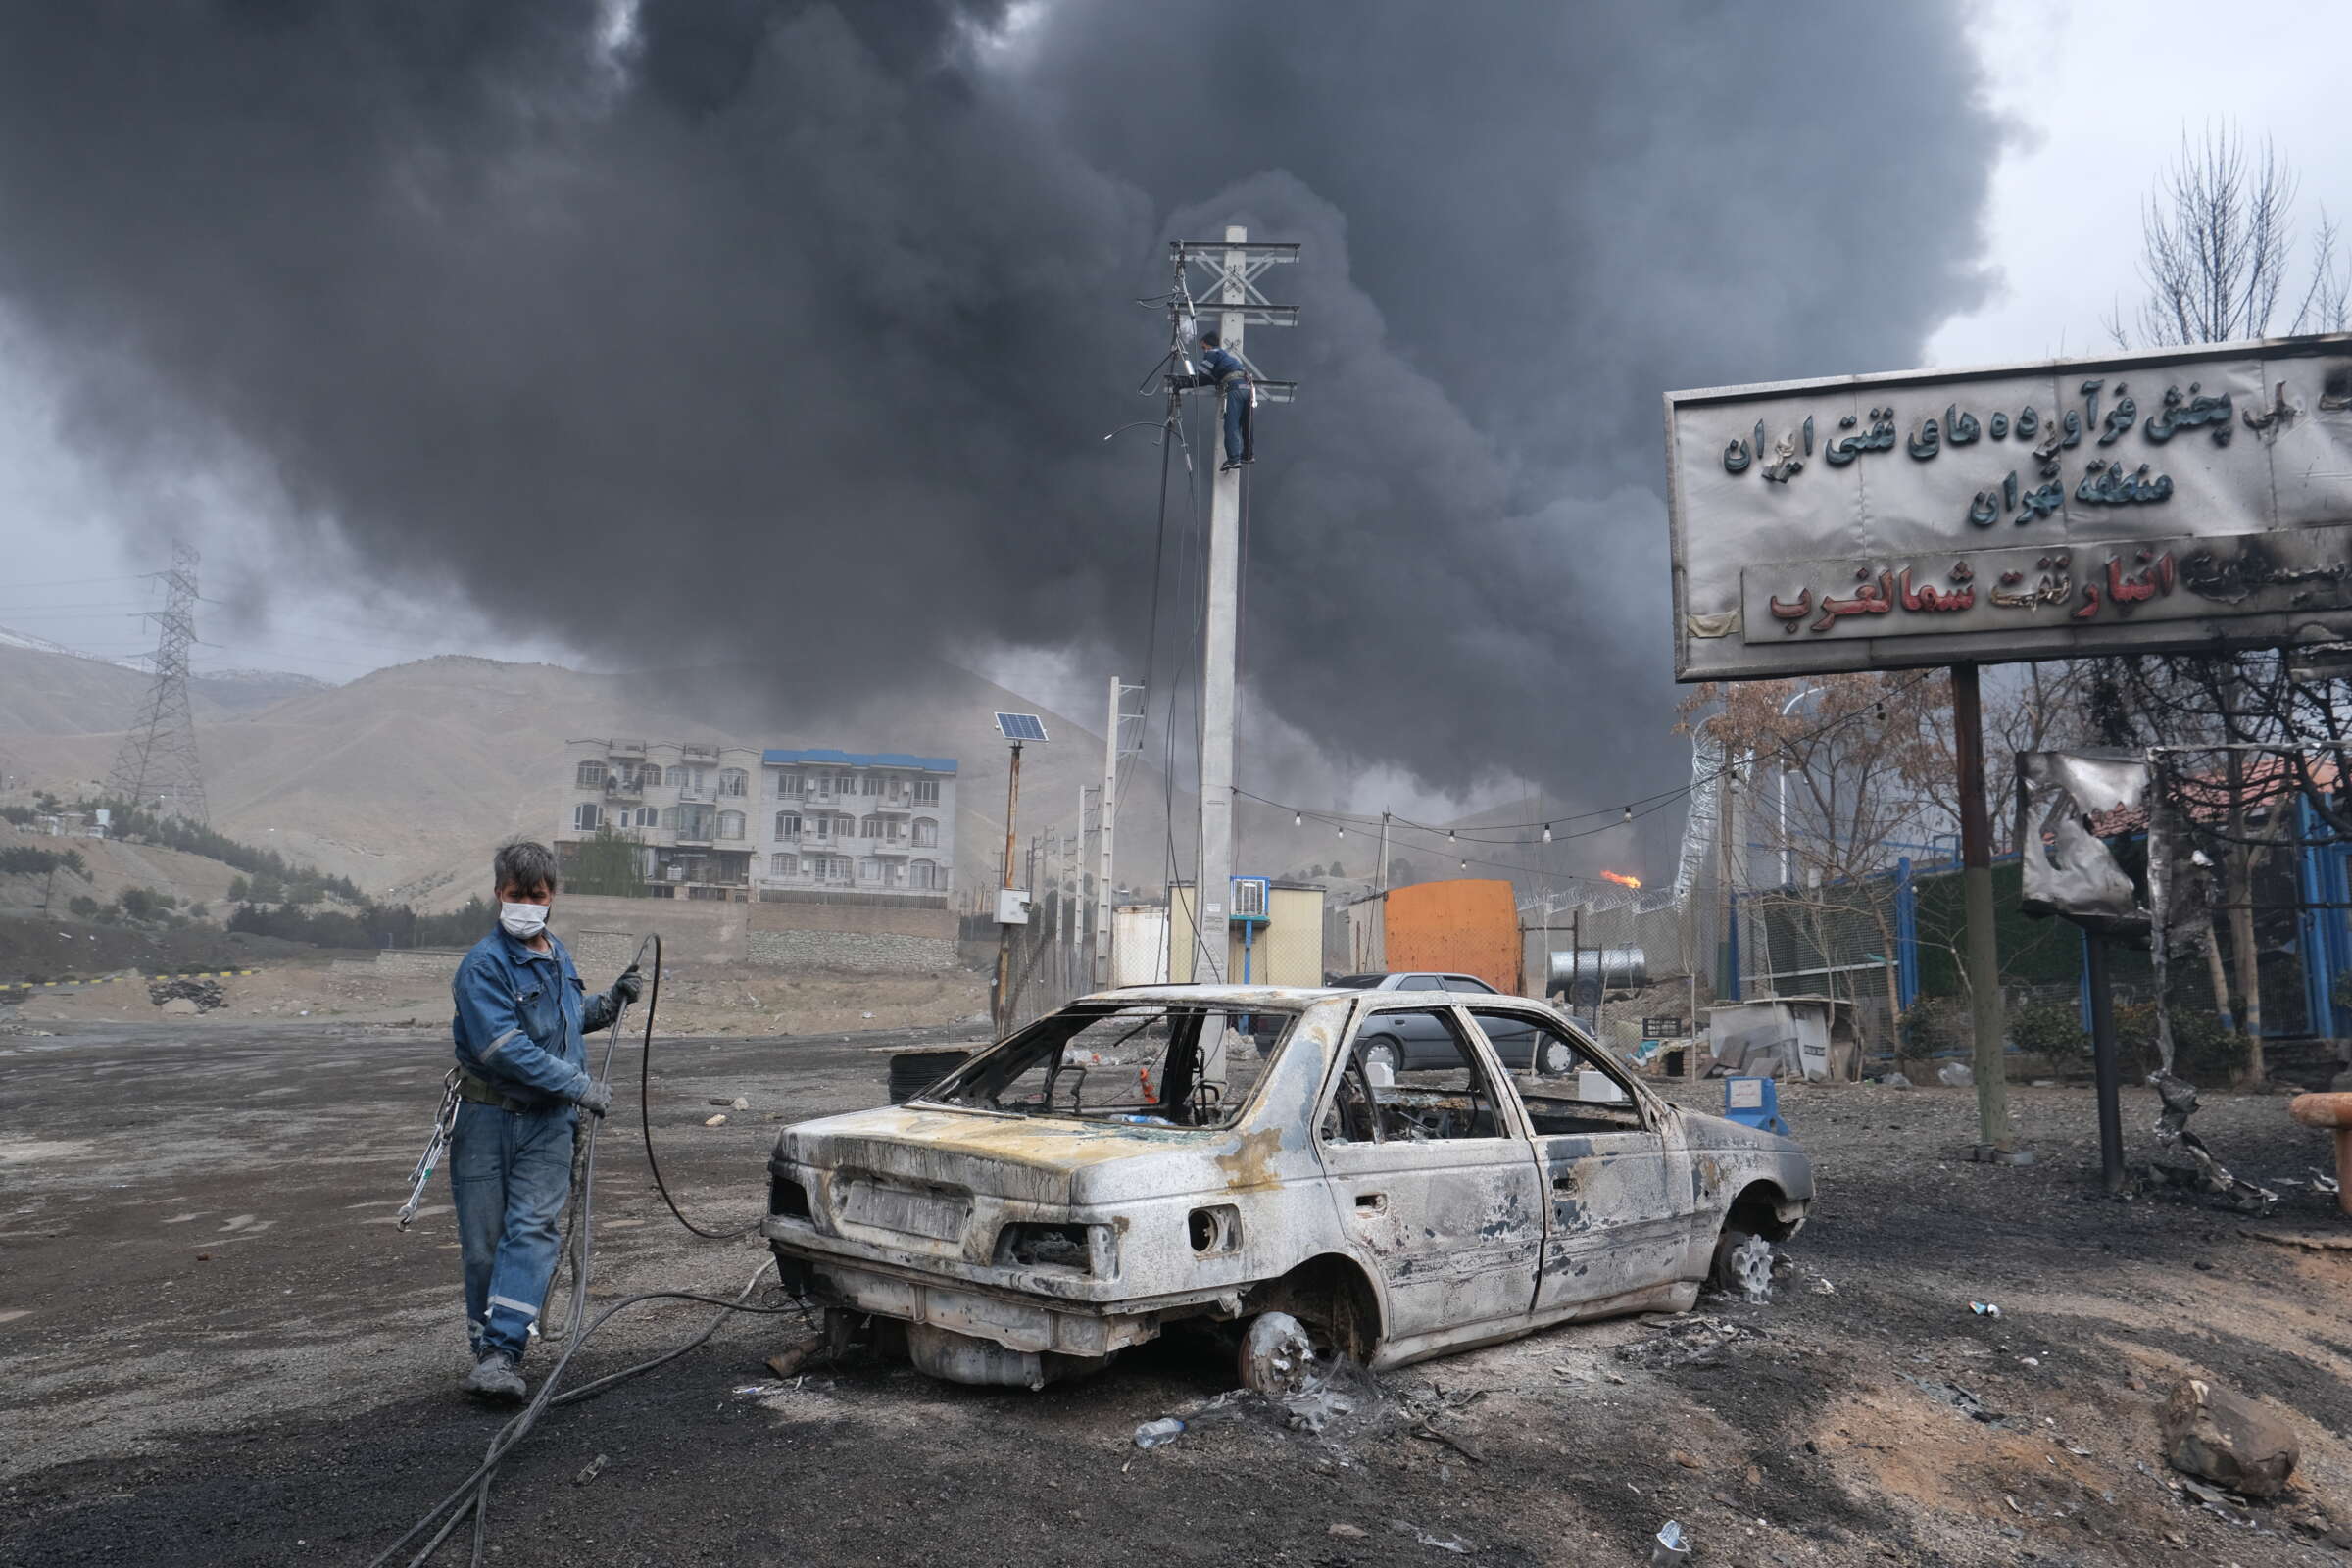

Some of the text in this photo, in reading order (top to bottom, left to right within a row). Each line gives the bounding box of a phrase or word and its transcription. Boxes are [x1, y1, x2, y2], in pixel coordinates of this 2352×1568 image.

[1824, 407, 1897, 466] نفتی
[1907, 402, 1982, 460] های
[2145, 381, 2233, 447] پخش
[1969, 458, 2174, 527] منطقه تهران
[2068, 547, 2176, 618] انبار
